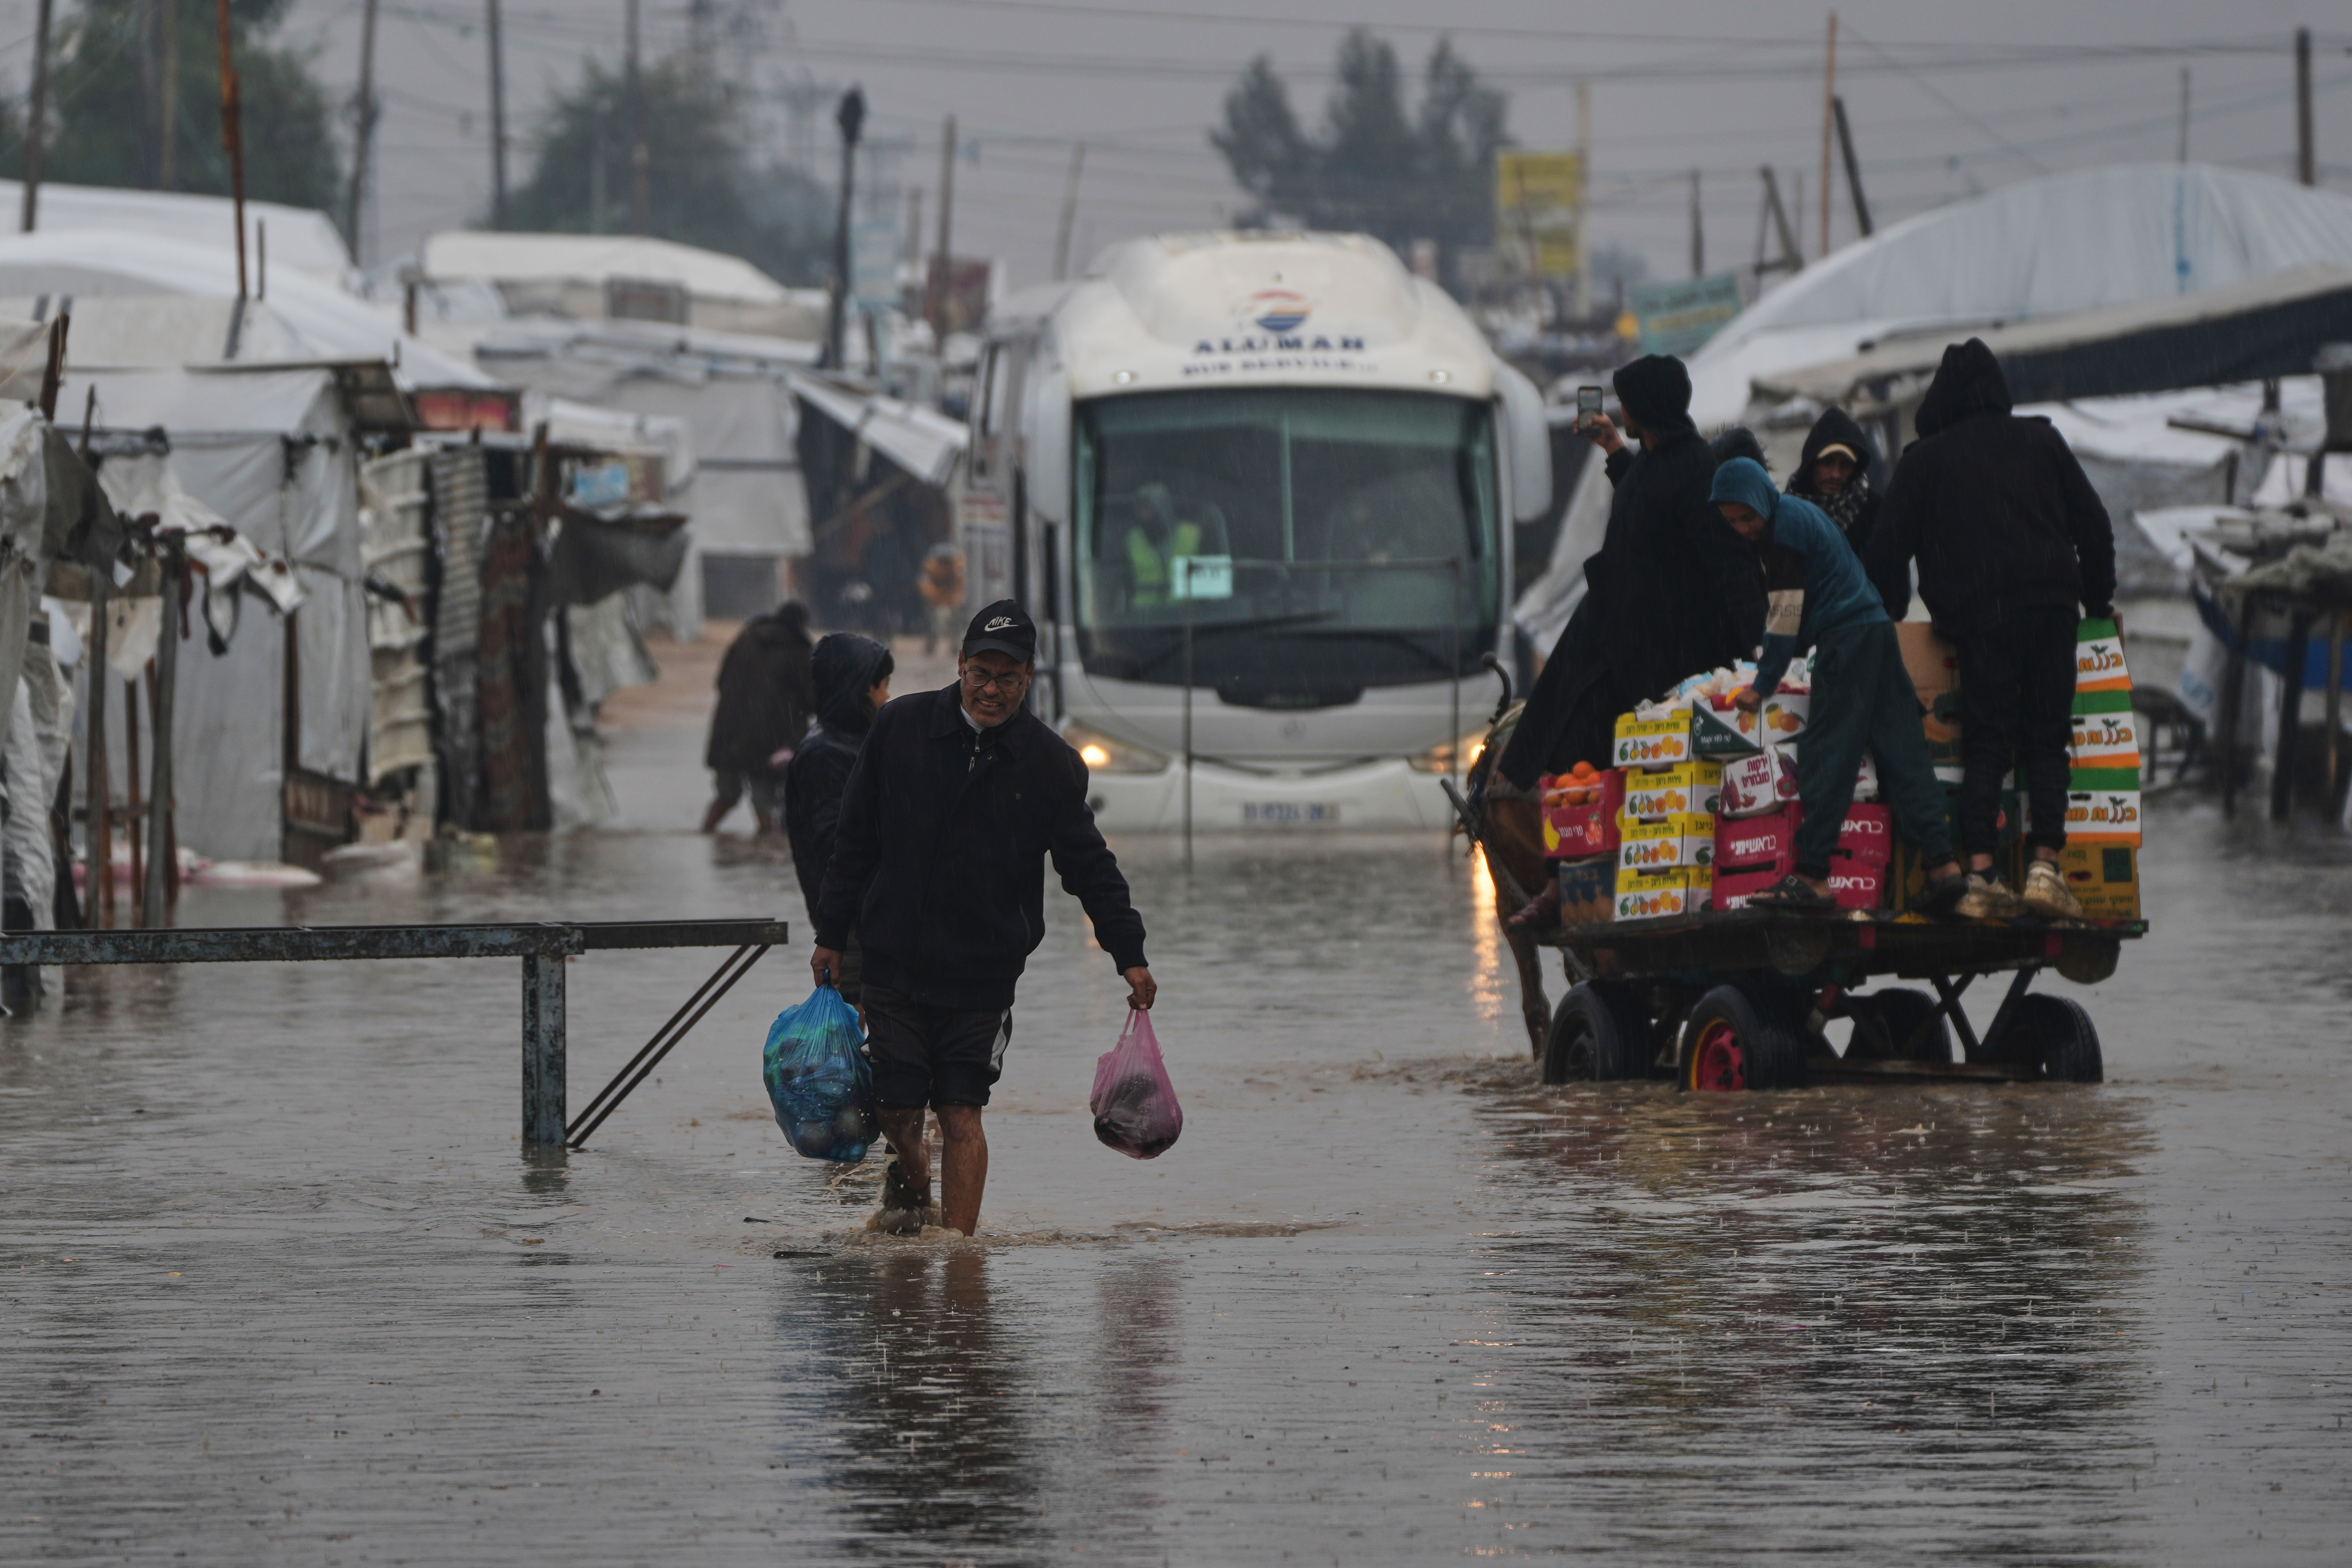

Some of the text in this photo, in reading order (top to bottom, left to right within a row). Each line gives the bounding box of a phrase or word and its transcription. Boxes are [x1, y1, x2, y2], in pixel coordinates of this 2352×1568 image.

[989, 616, 1012, 626] NIKE
[1747, 756, 1768, 773] ירקות
[1742, 771, 1770, 788] מובחרים
[1573, 825, 1583, 836] פרי
[1841, 820, 1883, 833] בראש
[1828, 876, 1876, 890] בראש
